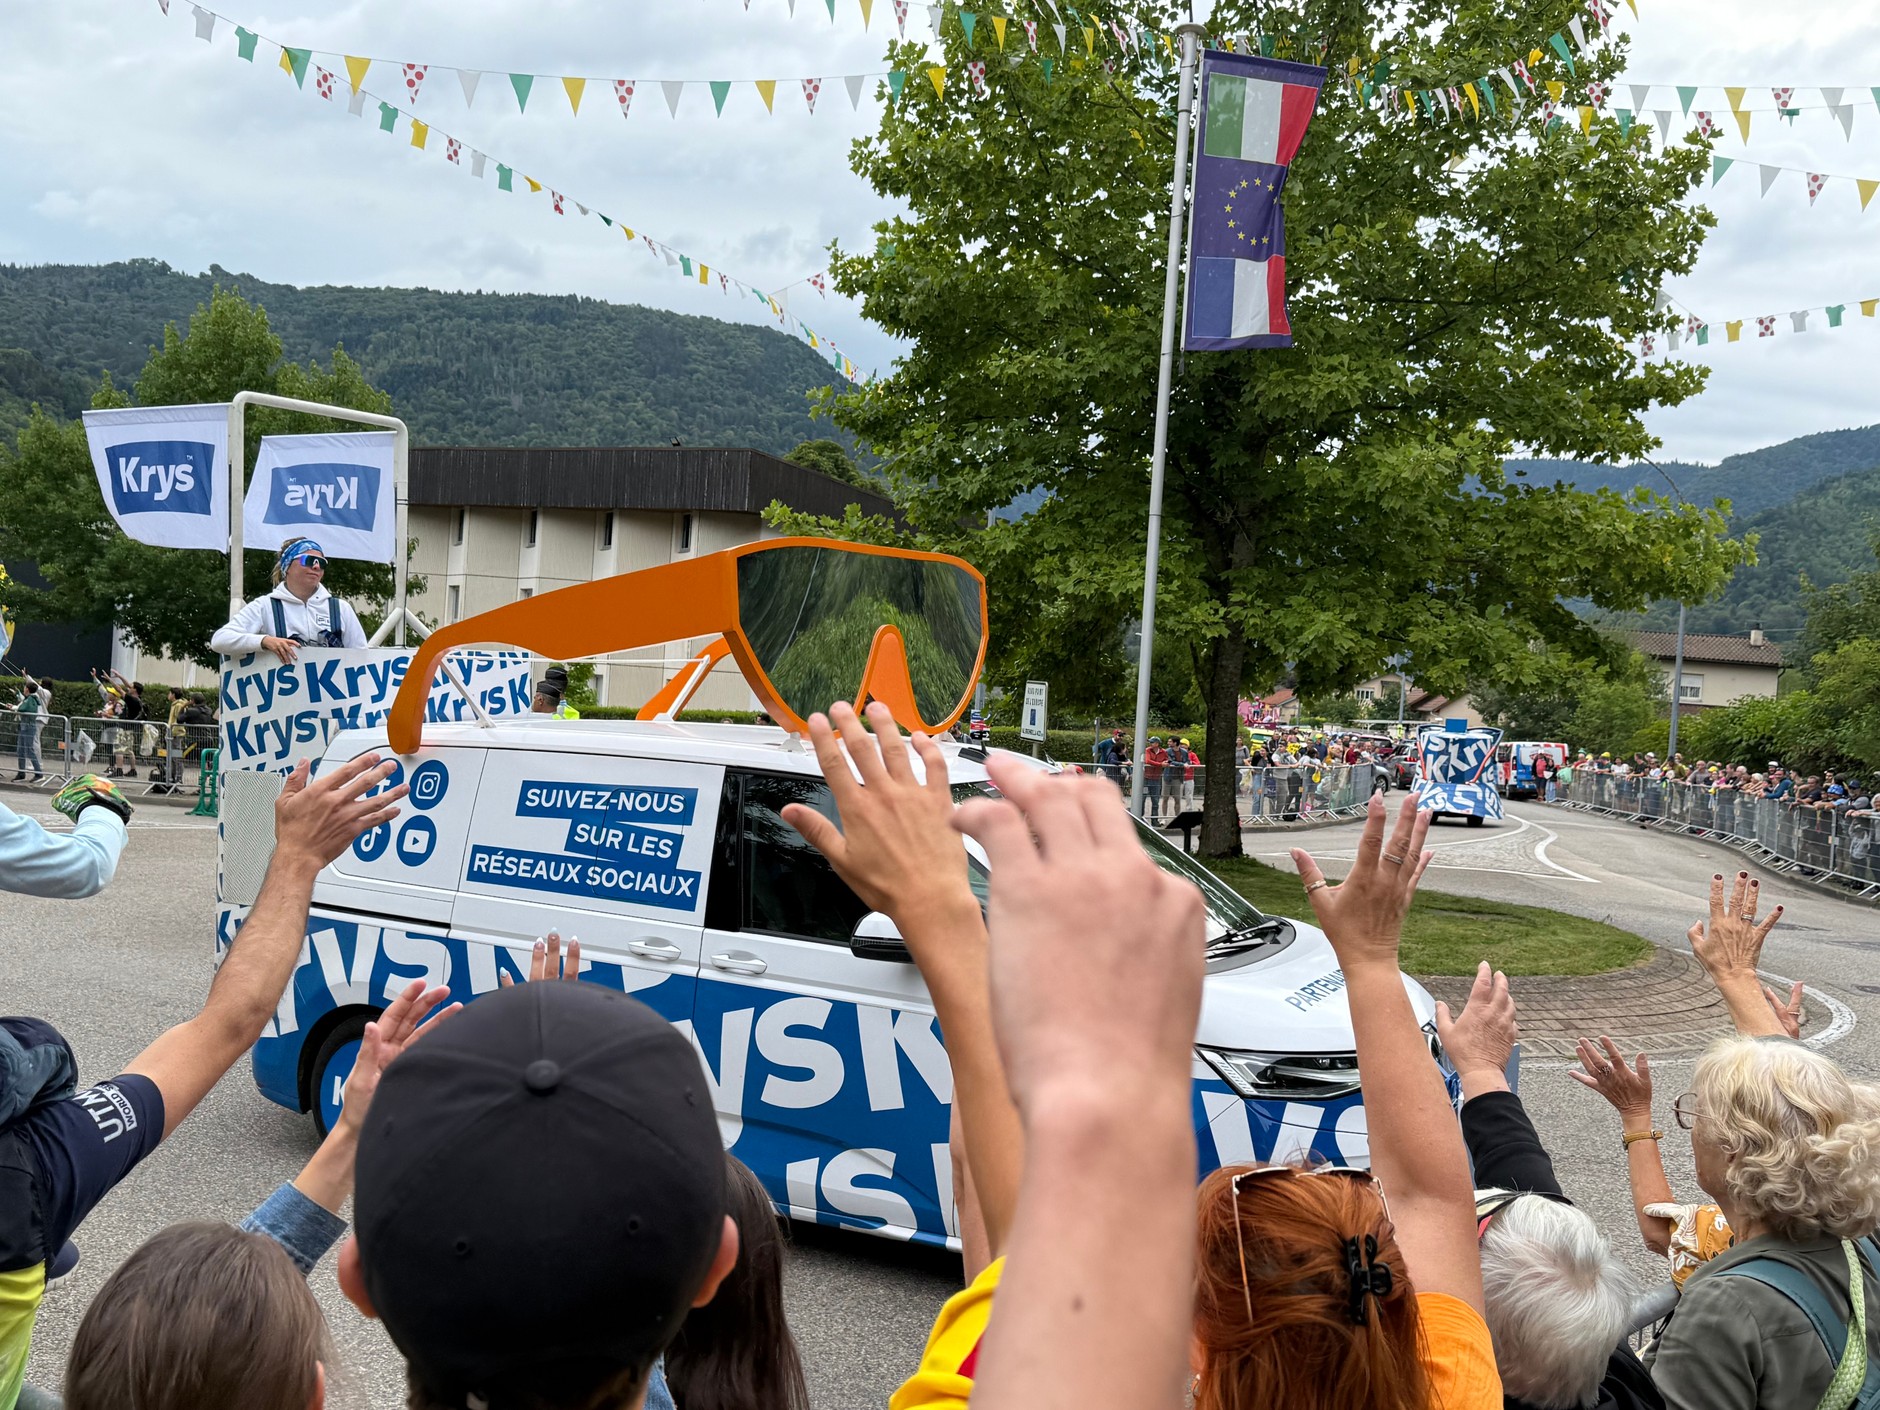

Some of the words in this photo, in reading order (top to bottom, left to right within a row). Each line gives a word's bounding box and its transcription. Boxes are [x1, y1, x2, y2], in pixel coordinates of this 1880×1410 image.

[119, 456, 195, 501] Krys
[221, 663, 300, 714] Krys
[226, 711, 320, 761] Krys
[525, 788, 685, 813] SUIVEZ-NOUS
[574, 823, 623, 850] SUR
[627, 832, 674, 859] LES
[473, 850, 582, 884] RÉSEAUX
[586, 866, 695, 898] SOCIAUX
[111, 1093, 135, 1127] WORLD
